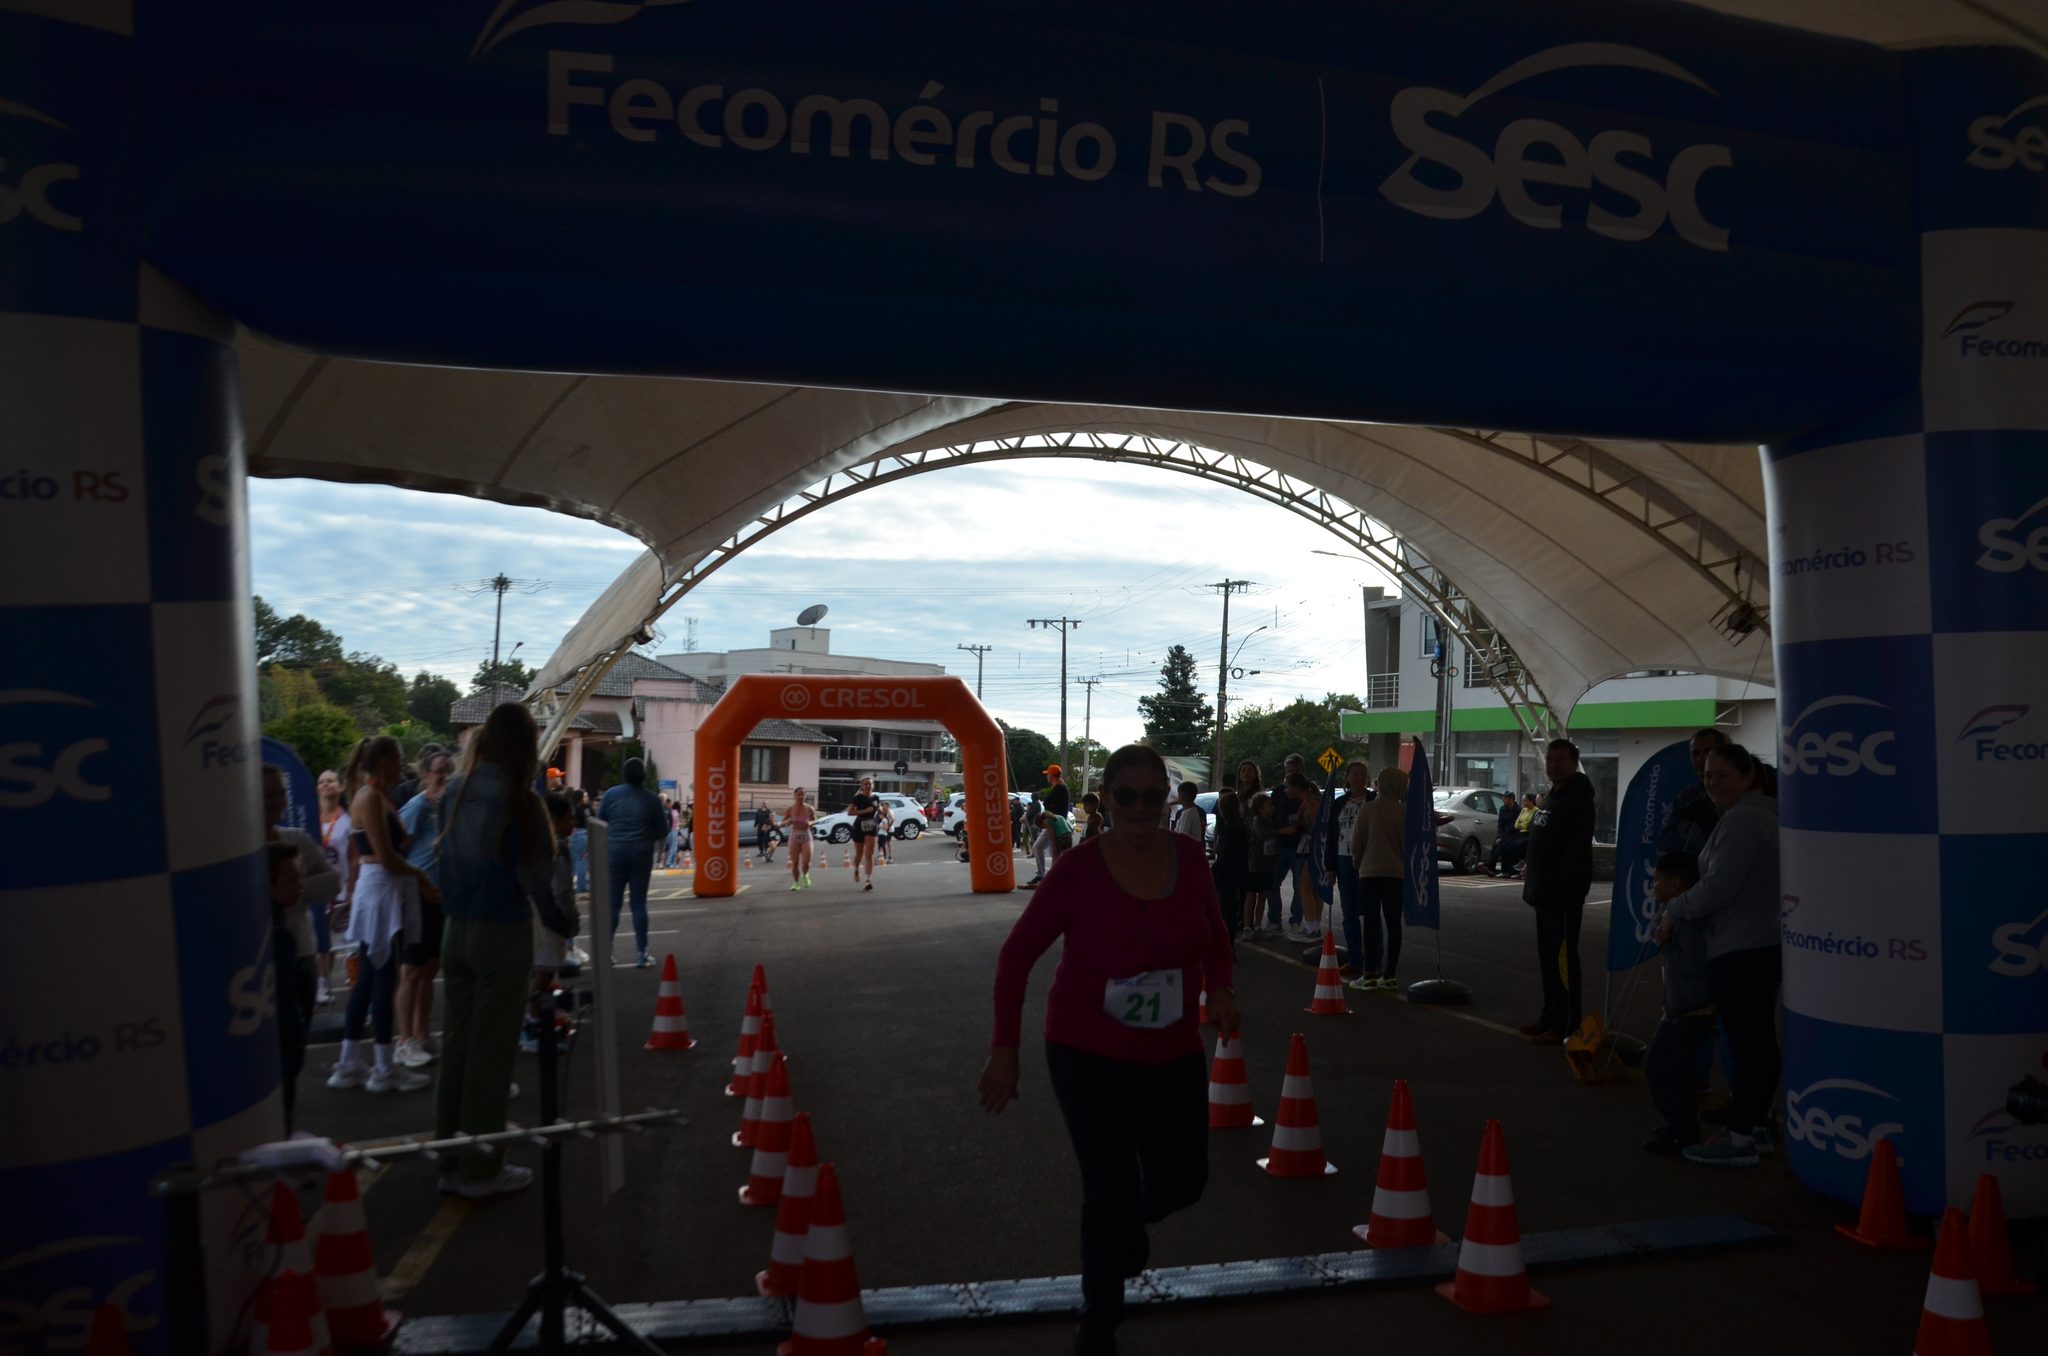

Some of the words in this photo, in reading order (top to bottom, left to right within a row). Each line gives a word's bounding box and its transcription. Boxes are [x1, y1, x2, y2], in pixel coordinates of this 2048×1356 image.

[546, 49, 1118, 182] Fecomércio
[1146, 110, 1264, 198] RS
[1378, 86, 1734, 252] Sesc
[73, 470, 130, 502] RS
[1876, 541, 1915, 565] RS
[818, 687, 926, 709] CRESOL
[707, 760, 727, 850] CRESOL
[982, 757, 1005, 847] CRESOL
[1887, 939, 1928, 962] RS
[1123, 991, 1160, 1022] 21
[114, 1017, 168, 1054] RS
